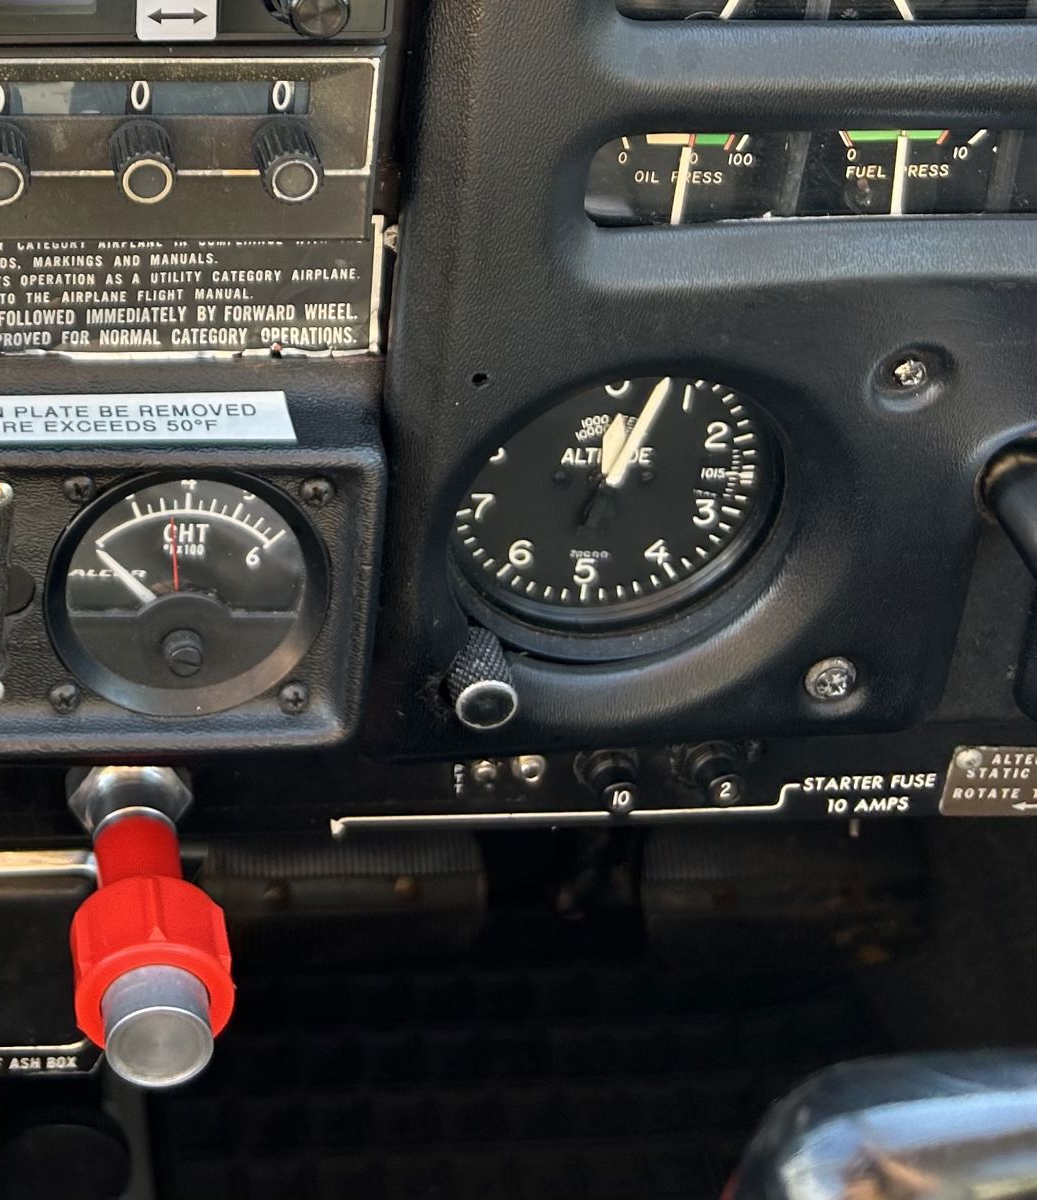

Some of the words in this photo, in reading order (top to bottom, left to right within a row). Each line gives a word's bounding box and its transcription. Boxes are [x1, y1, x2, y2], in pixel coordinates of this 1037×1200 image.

[634, 170, 660, 184] OIL
[845, 165, 887, 179] FUEL
[0, 292, 15, 305] TO
[25, 291, 51, 305] THE
[61, 290, 127, 304] AIRPLANE
[137, 288, 184, 302] FLIGHT
[194, 287, 254, 301] MANUAL.
[86, 305, 187, 325] IMMEDIATELY
[197, 305, 217, 323] BY
[224, 303, 295, 322] FORWARD
[304, 302, 358, 320] WHEEL.
[61, 329, 91, 345] FOR
[99, 327, 161, 346] NORMAL
[171, 327, 248, 345] CATEGORY
[260, 326, 358, 346] OPERATIONS.
[15, 405, 89, 419] PLATE
[99, 405, 130, 418] BE
[140, 403, 257, 417] REMOVED
[45, 419, 157, 433] EXCEEDS
[167, 419, 219, 432] 50°F
[966, 767, 1031, 779] STATIC
[802, 774, 888, 792] STARTER
[892, 772, 937, 790] FUSE
[952, 787, 1021, 799] ROTATE
[827, 797, 849, 814] 10
[854, 796, 910, 813] AMPS
[8, 1056, 41, 1070] ASH
[46, 1055, 78, 1069] BOX
